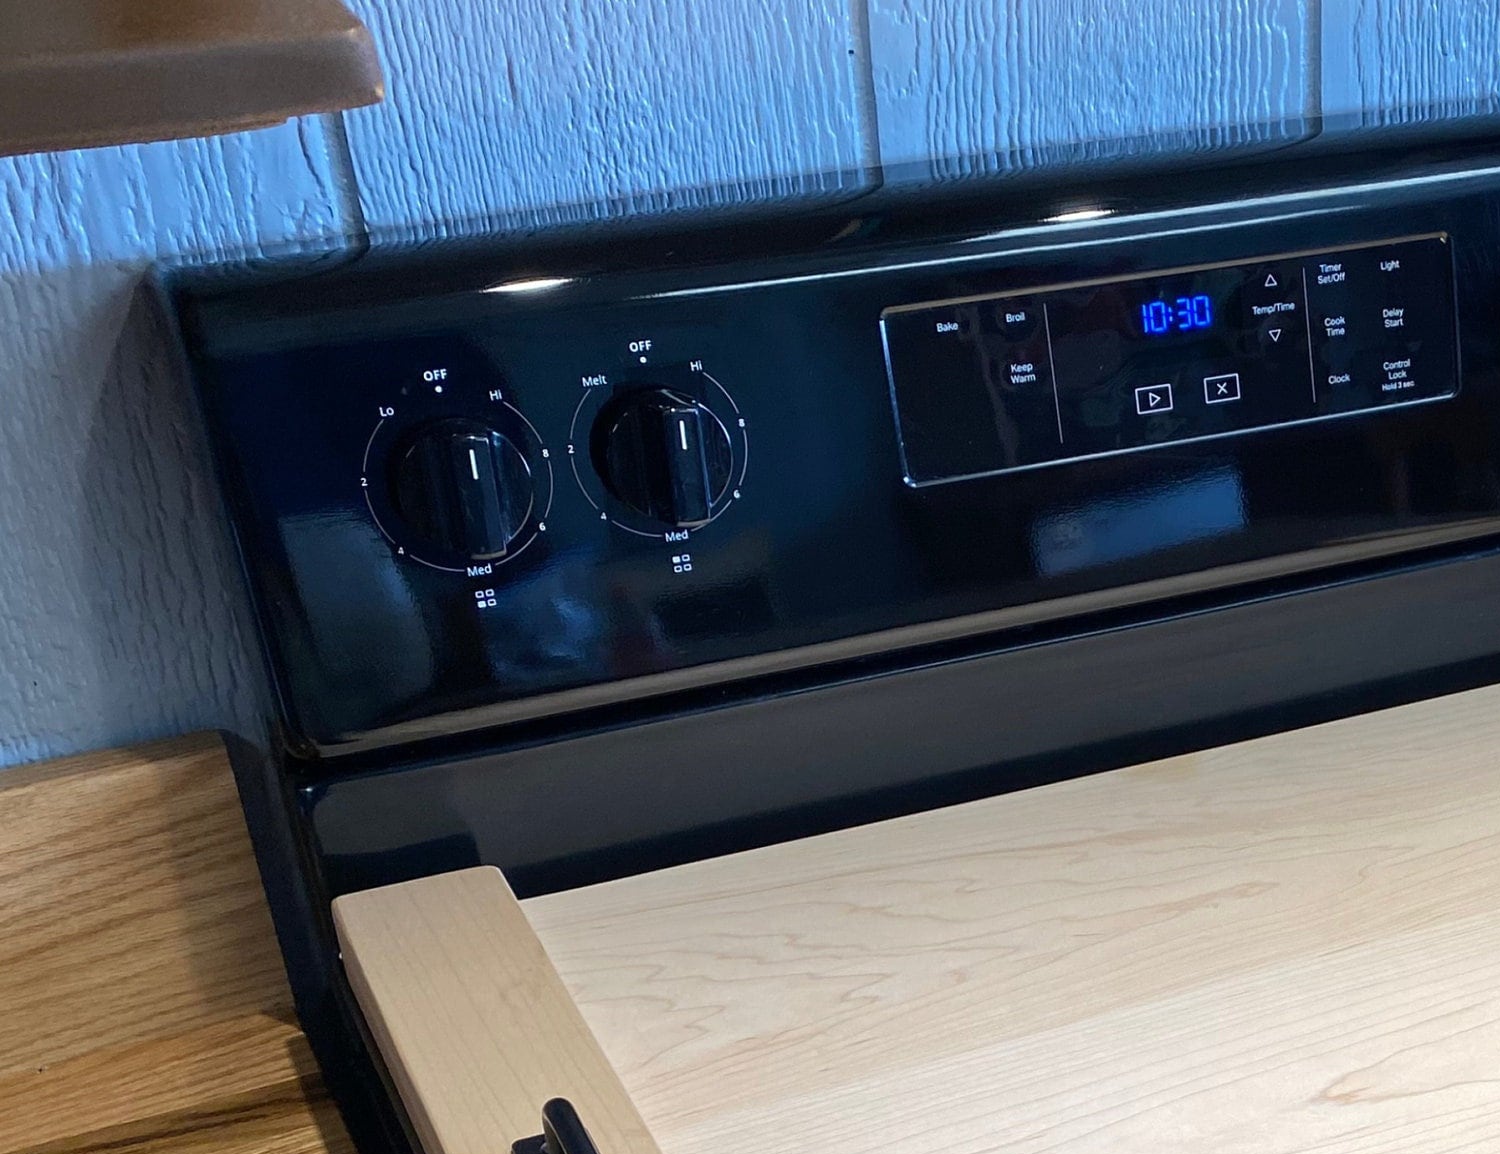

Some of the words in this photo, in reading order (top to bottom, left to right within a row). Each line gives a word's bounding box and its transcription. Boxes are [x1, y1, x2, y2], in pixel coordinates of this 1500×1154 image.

[1319, 263, 1342, 273] Timer
[1380, 260, 1400, 271] Light
[1317, 272, 1346, 284] Set/Off
[1252, 301, 1295, 316] Temp/Time
[1382, 308, 1404, 319] Delay
[1005, 311, 1026, 323] Broil
[1142, 295, 1212, 335] 10:30
[936, 320, 959, 333] Bake
[1324, 316, 1346, 327] Cook
[1384, 318, 1404, 328] Start
[1326, 327, 1345, 337] Time
[629, 340, 652, 352] OFF
[690, 360, 703, 372] Hi
[1010, 362, 1033, 375] Keep
[1383, 358, 1411, 371] Control
[424, 369, 447, 381] OFF
[582, 374, 607, 387] Melt
[1010, 371, 1036, 383] Warm
[1328, 372, 1350, 384] Clock
[1388, 370, 1407, 380] Lock
[489, 390, 502, 401] Hi
[379, 405, 394, 417] Lo
[567, 445, 574, 454] 2
[361, 477, 368, 487] 2
[734, 489, 740, 498] 6
[600, 511, 607, 520] 4
[539, 522, 546, 531] 6
[665, 529, 689, 542] Med
[397, 546, 405, 555] 4
[467, 563, 492, 576] Med
